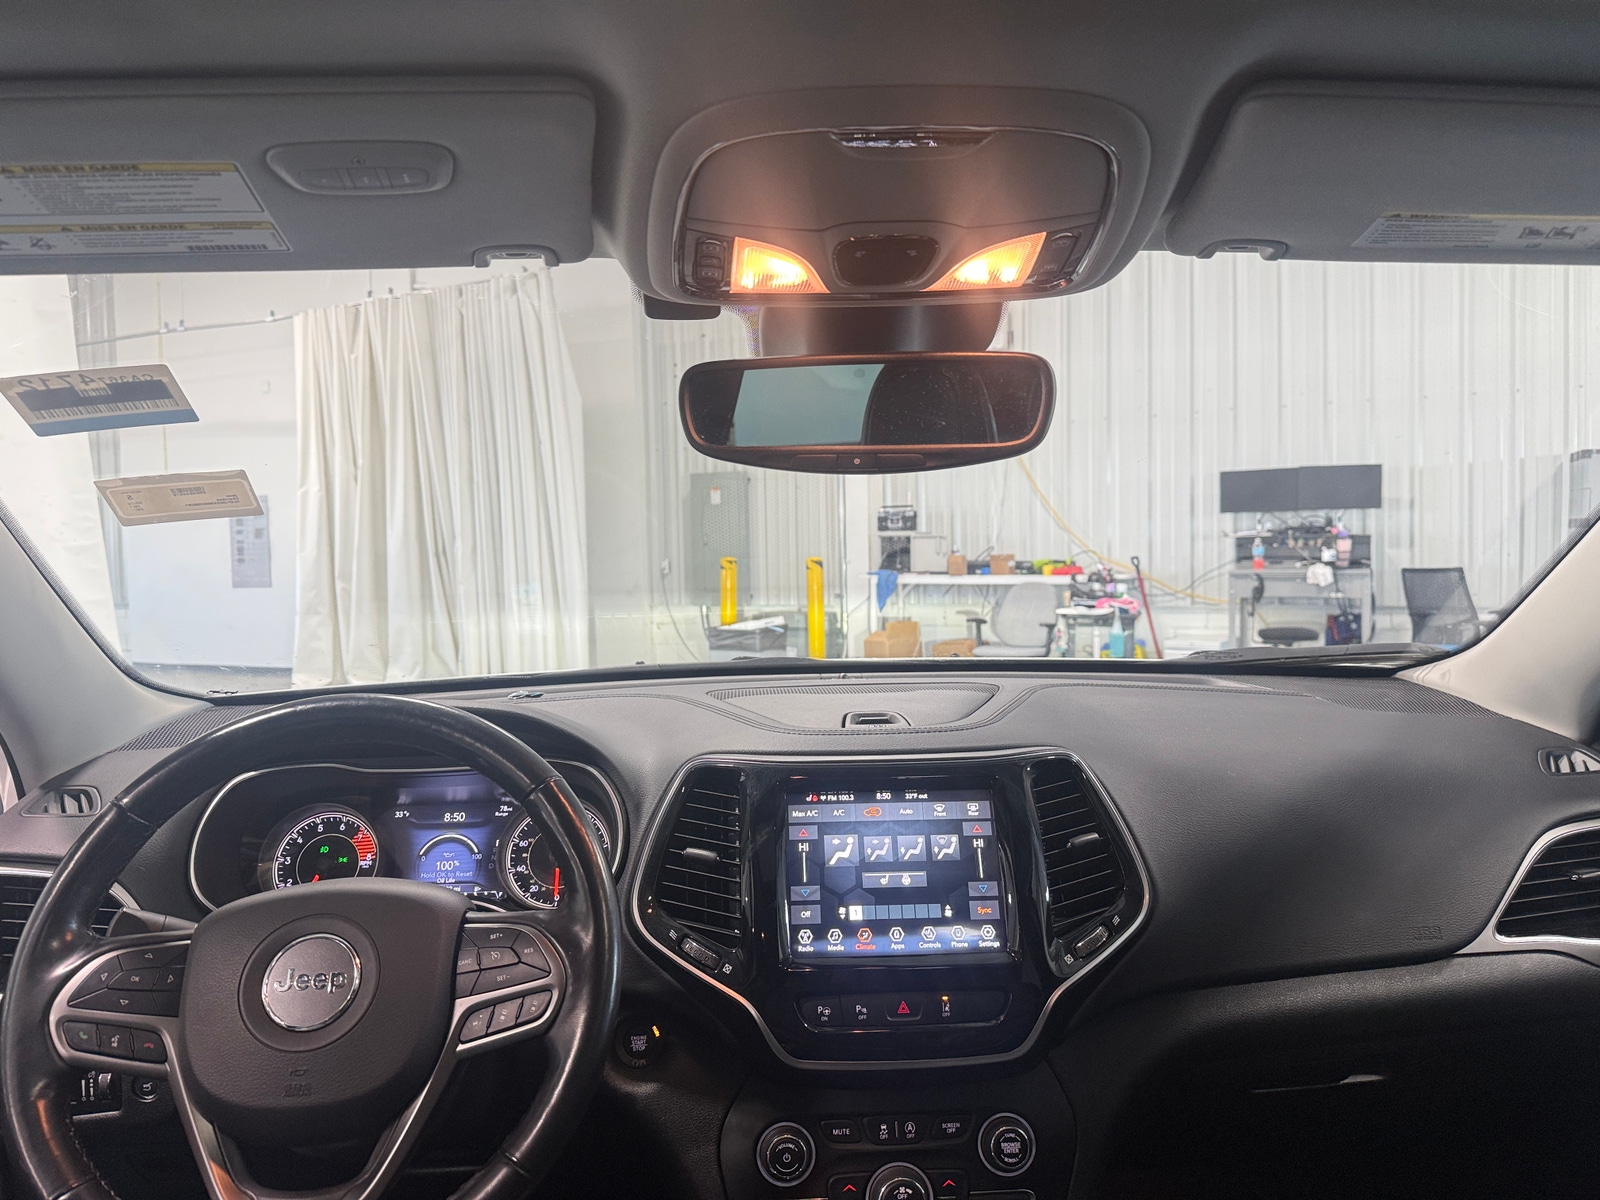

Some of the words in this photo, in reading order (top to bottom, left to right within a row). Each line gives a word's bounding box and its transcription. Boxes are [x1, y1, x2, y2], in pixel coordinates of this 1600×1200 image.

[140, 223, 186, 231] GARDE
[876, 792, 891, 800] 8:50
[444, 812, 466, 822] 8:50
[806, 809, 819, 817] A/C
[317, 824, 324, 832] 5
[339, 823, 346, 831] 6
[357, 834, 363, 842] 7
[798, 842, 809, 852] HI
[973, 838, 984, 848] HI
[284, 856, 291, 865] 3
[366, 852, 372, 861] 8
[516, 864, 526, 872] 40
[455, 870, 473, 878] Reset
[286, 878, 293, 887] 2
[529, 884, 539, 892] 20
[800, 910, 811, 918] Off
[977, 906, 992, 915] Sync
[855, 943, 876, 951] Climate
[890, 942, 905, 950] Apps
[918, 941, 942, 949] Controls
[978, 940, 1000, 949] Settings
[273, 967, 348, 994] Jeep
[832, 1128, 850, 1136] MUTE
